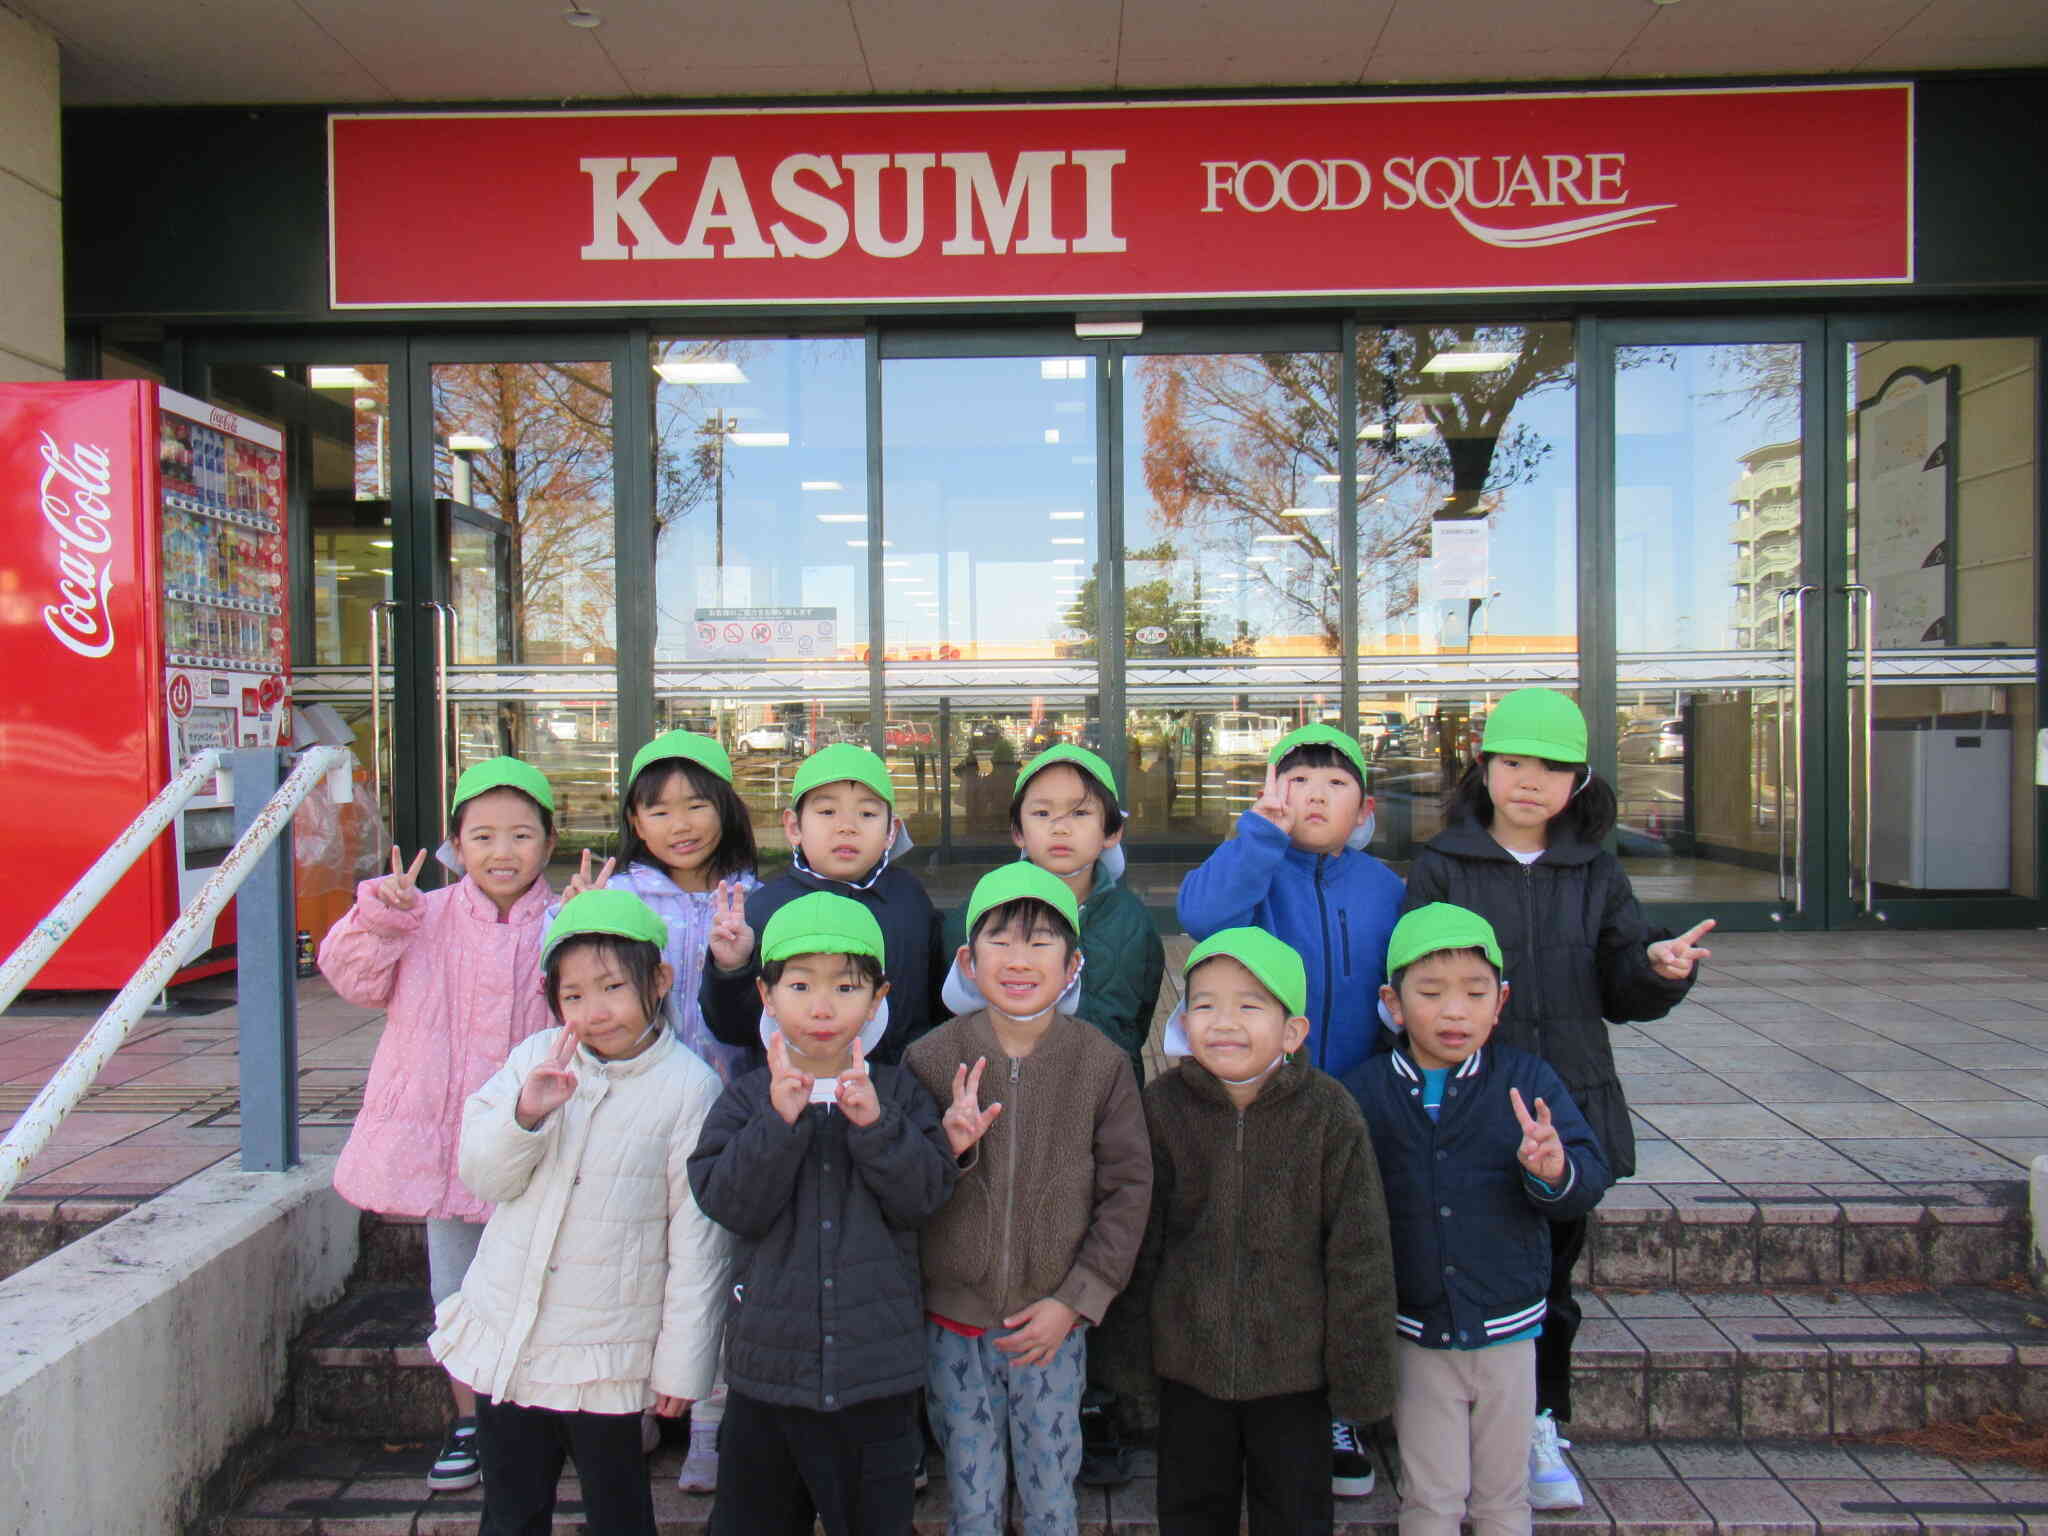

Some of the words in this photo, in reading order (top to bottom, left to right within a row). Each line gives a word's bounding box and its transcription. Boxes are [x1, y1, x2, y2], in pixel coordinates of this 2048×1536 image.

[580, 149, 1127, 260] KASUMI
[1200, 159, 1371, 212] FOOD
[41, 430, 115, 658] Coca-Cola
